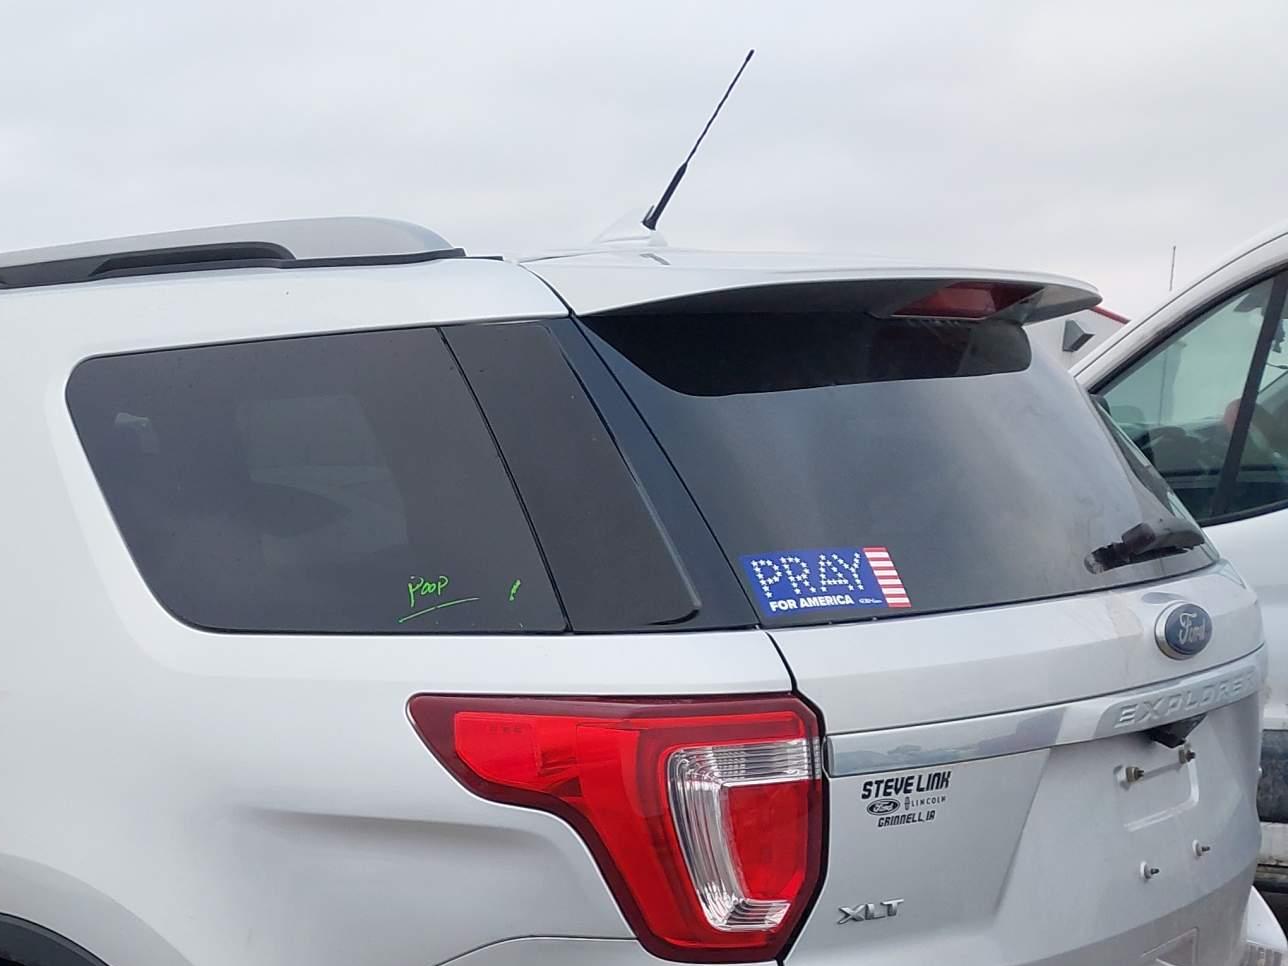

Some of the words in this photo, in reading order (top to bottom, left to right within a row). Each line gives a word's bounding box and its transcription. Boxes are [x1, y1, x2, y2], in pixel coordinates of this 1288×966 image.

[751, 552, 864, 599] PRAY
[770, 598, 798, 612] FOR
[800, 594, 856, 609] AMERICA
[1178, 612, 1207, 645] Ford
[861, 775, 915, 800] STEVE
[916, 770, 952, 793] LINK
[911, 796, 947, 808] LINCOLN
[925, 810, 936, 821] IA
[837, 898, 905, 925] XLT
